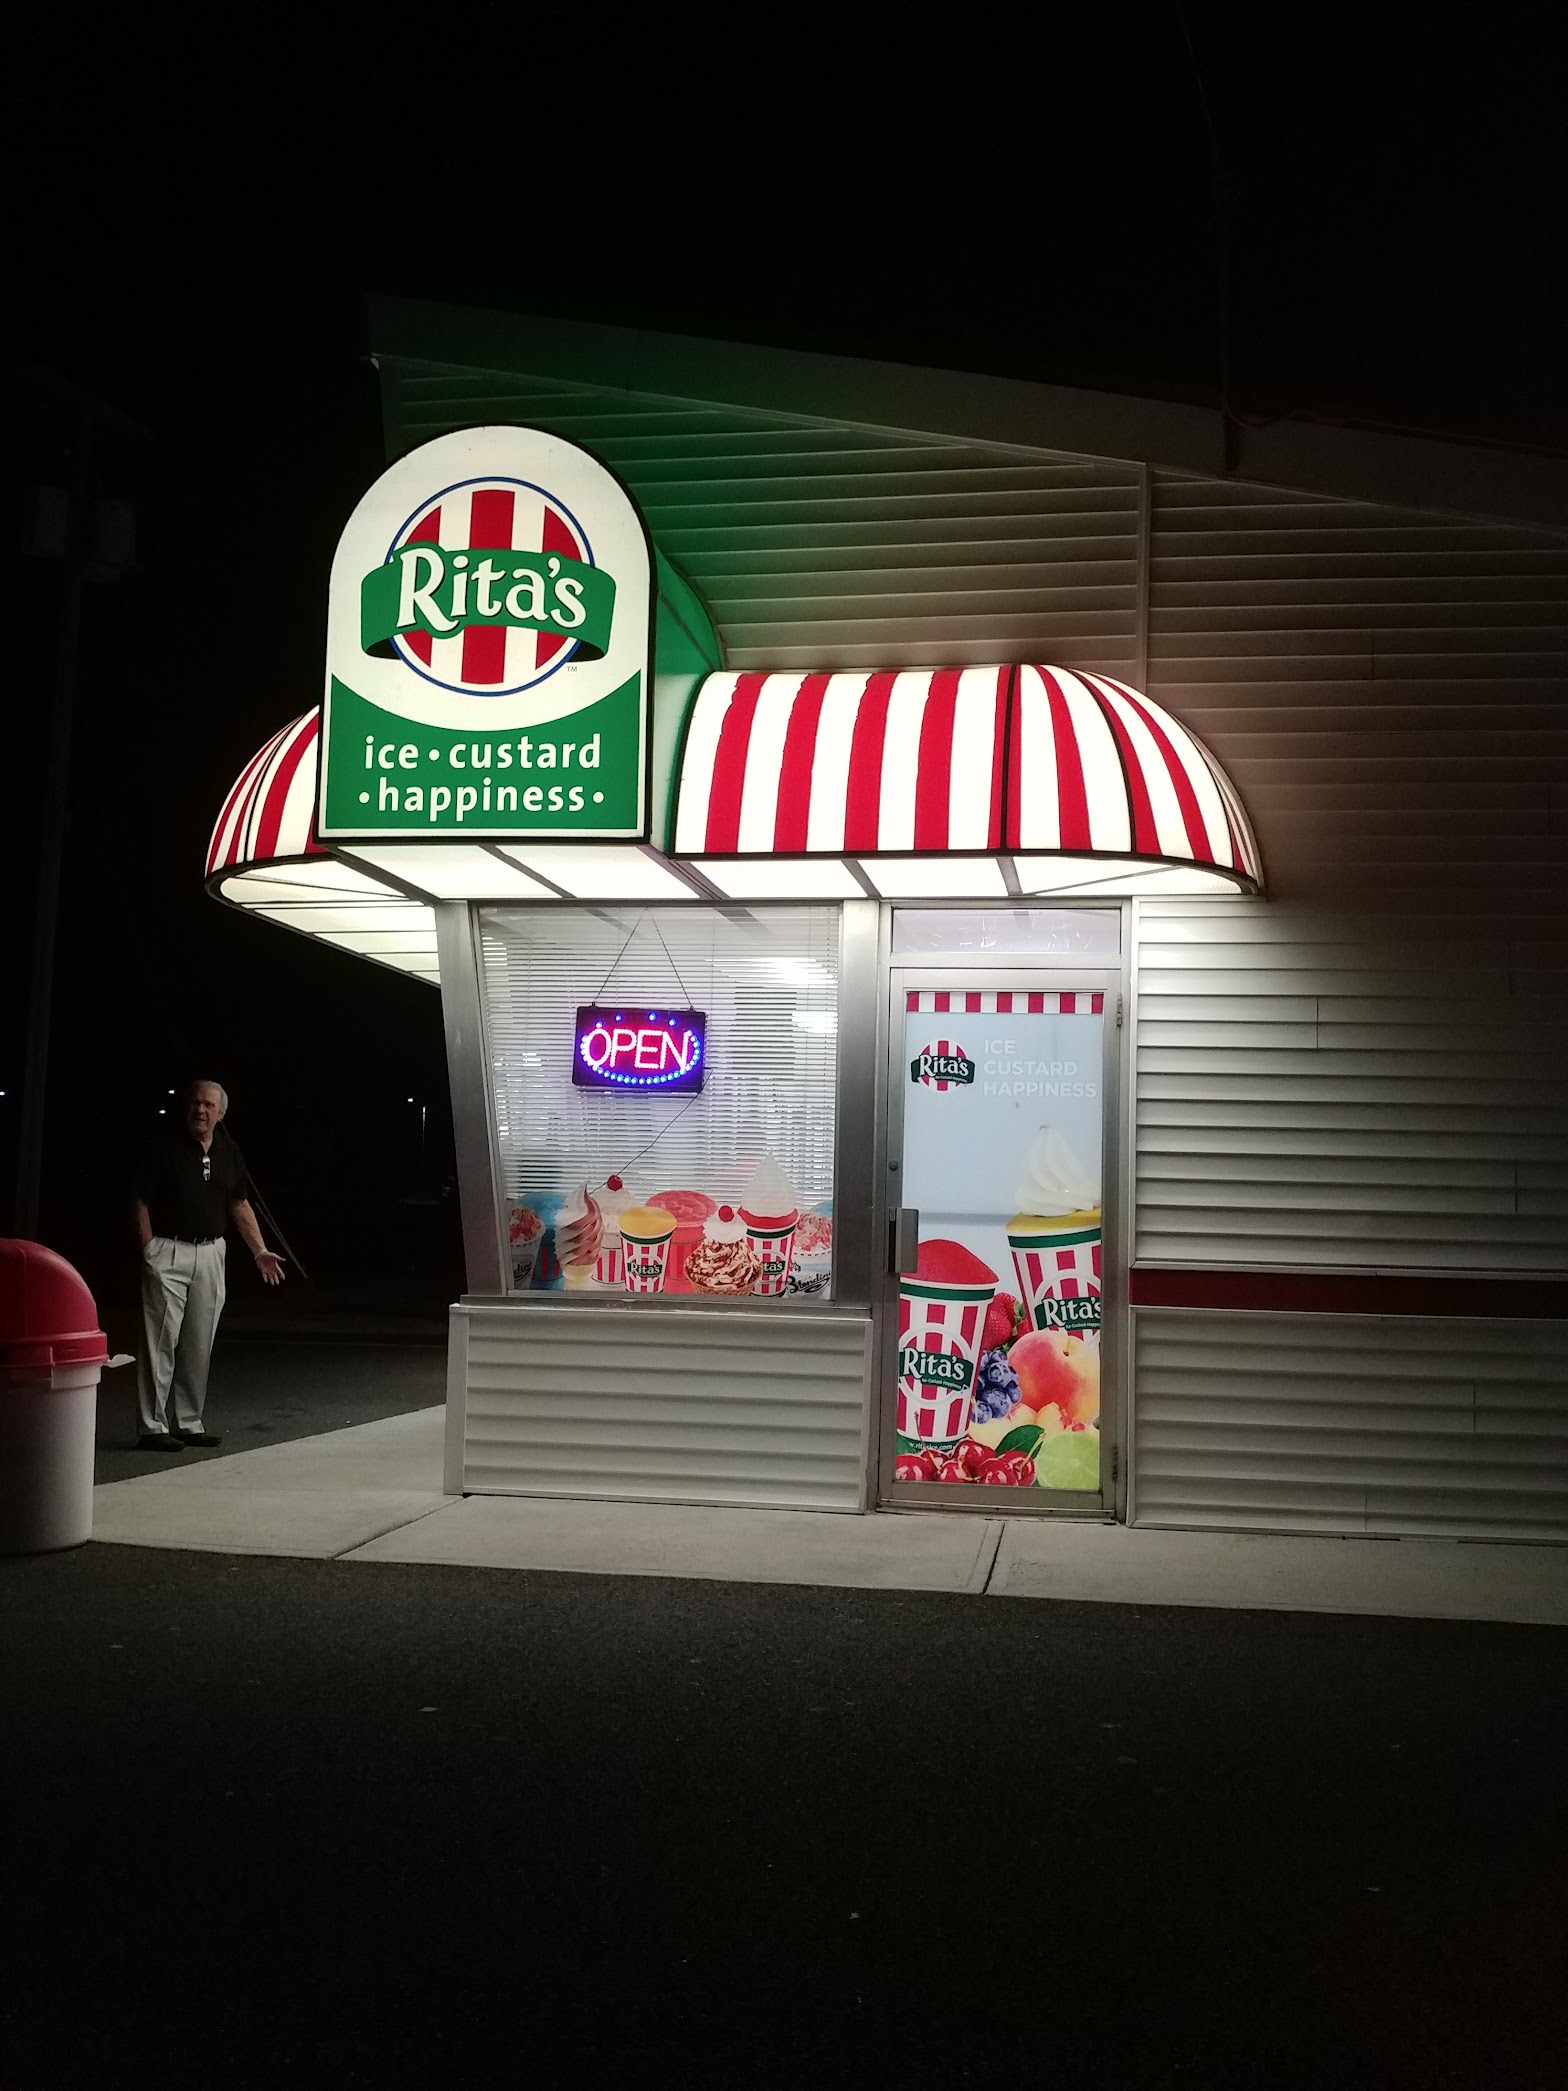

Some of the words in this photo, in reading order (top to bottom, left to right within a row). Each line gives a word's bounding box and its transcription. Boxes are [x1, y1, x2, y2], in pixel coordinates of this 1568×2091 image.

[396, 547, 588, 633] Rita's
[364, 735, 419, 770] ice
[448, 732, 601, 770] custard
[377, 776, 586, 822] happiness
[586, 1027, 693, 1075] OPEN
[984, 1039, 1017, 1055] ICE
[919, 1053, 969, 1077] Rita's
[983, 1060, 1079, 1077] CUSTARD
[983, 1081, 1098, 1098] HAPPINESS
[630, 1262, 661, 1276] Rita's
[903, 1346, 965, 1381] Rita's
